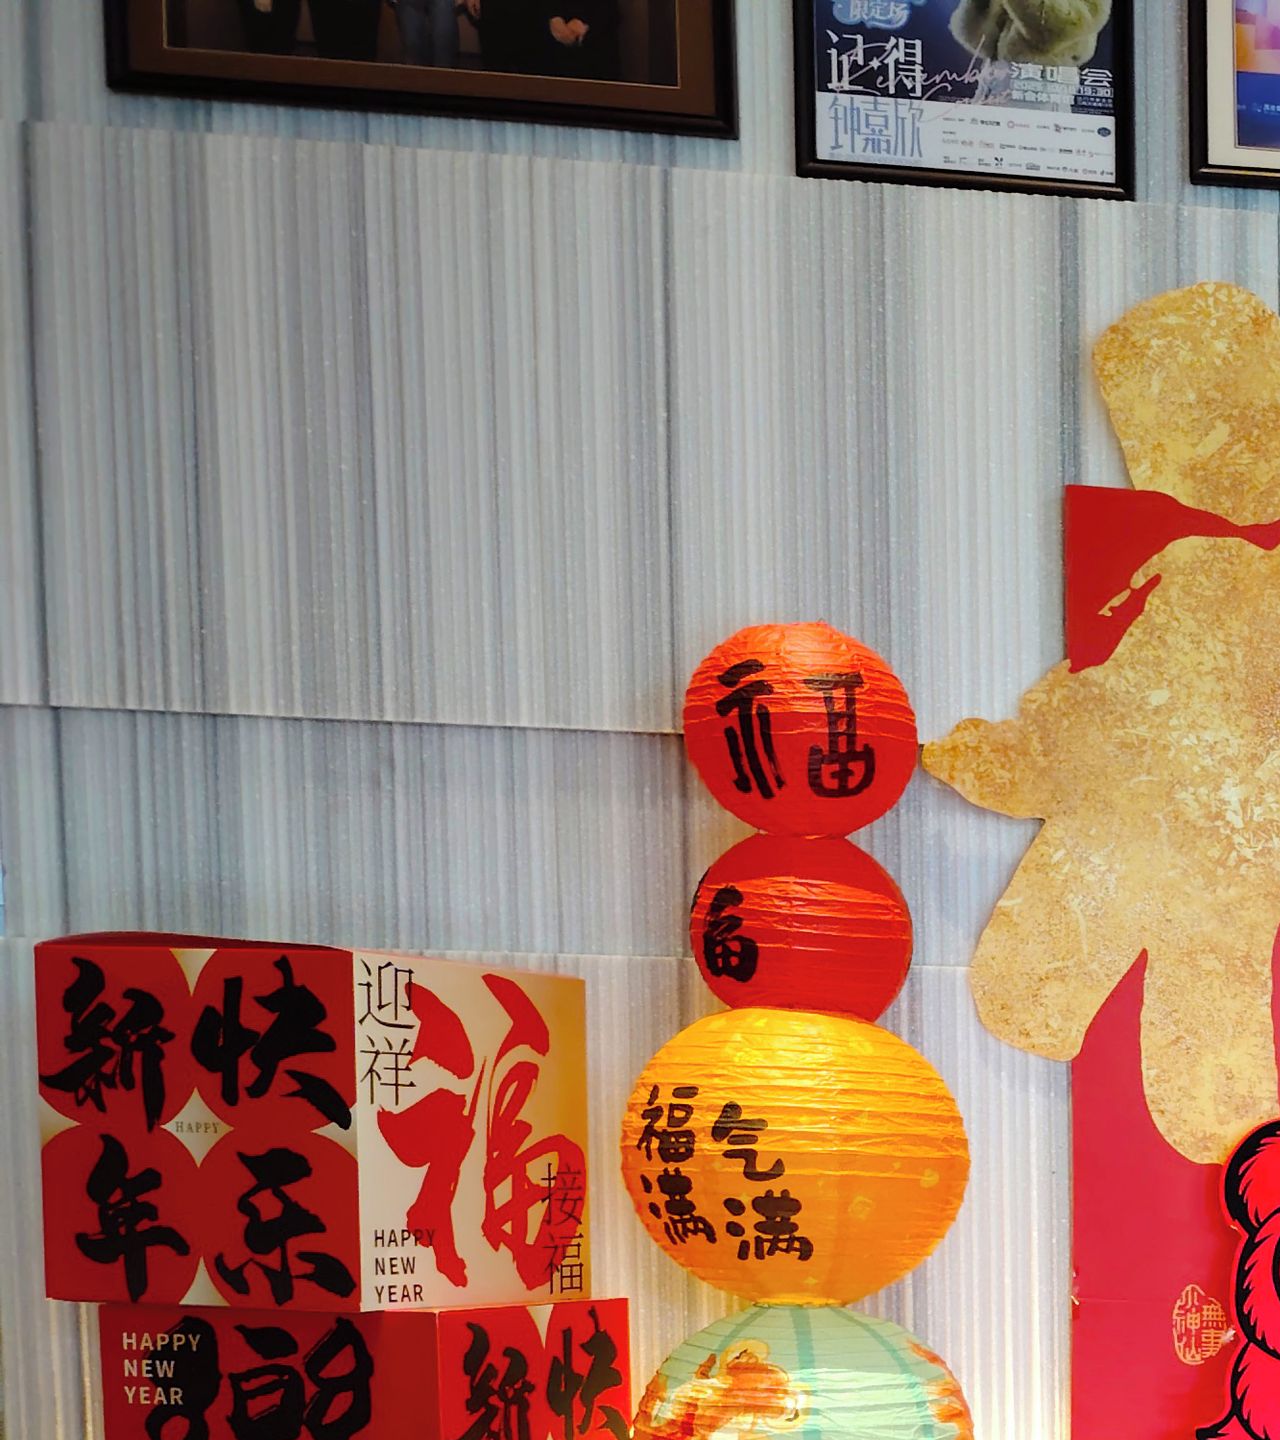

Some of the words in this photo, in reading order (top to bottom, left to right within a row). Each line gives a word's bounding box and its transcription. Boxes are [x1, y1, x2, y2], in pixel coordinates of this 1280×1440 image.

[826, 29, 927, 98] 记得
[1010, 62, 1113, 87] 演唱会
[715, 658, 876, 800] 福
[357, 958, 417, 1107] 迎祥
[174, 1120, 220, 1135] HAPPY
[376, 973, 587, 1291] 福
[373, 1228, 437, 1249] HAPPY
[540, 1162, 585, 1296] 接福
[374, 1256, 417, 1277] NEW
[375, 1283, 425, 1304] YEAR
[121, 1332, 202, 1353] HAPPY
[123, 1359, 176, 1380] NEW
[123, 1385, 185, 1406] YEAR
